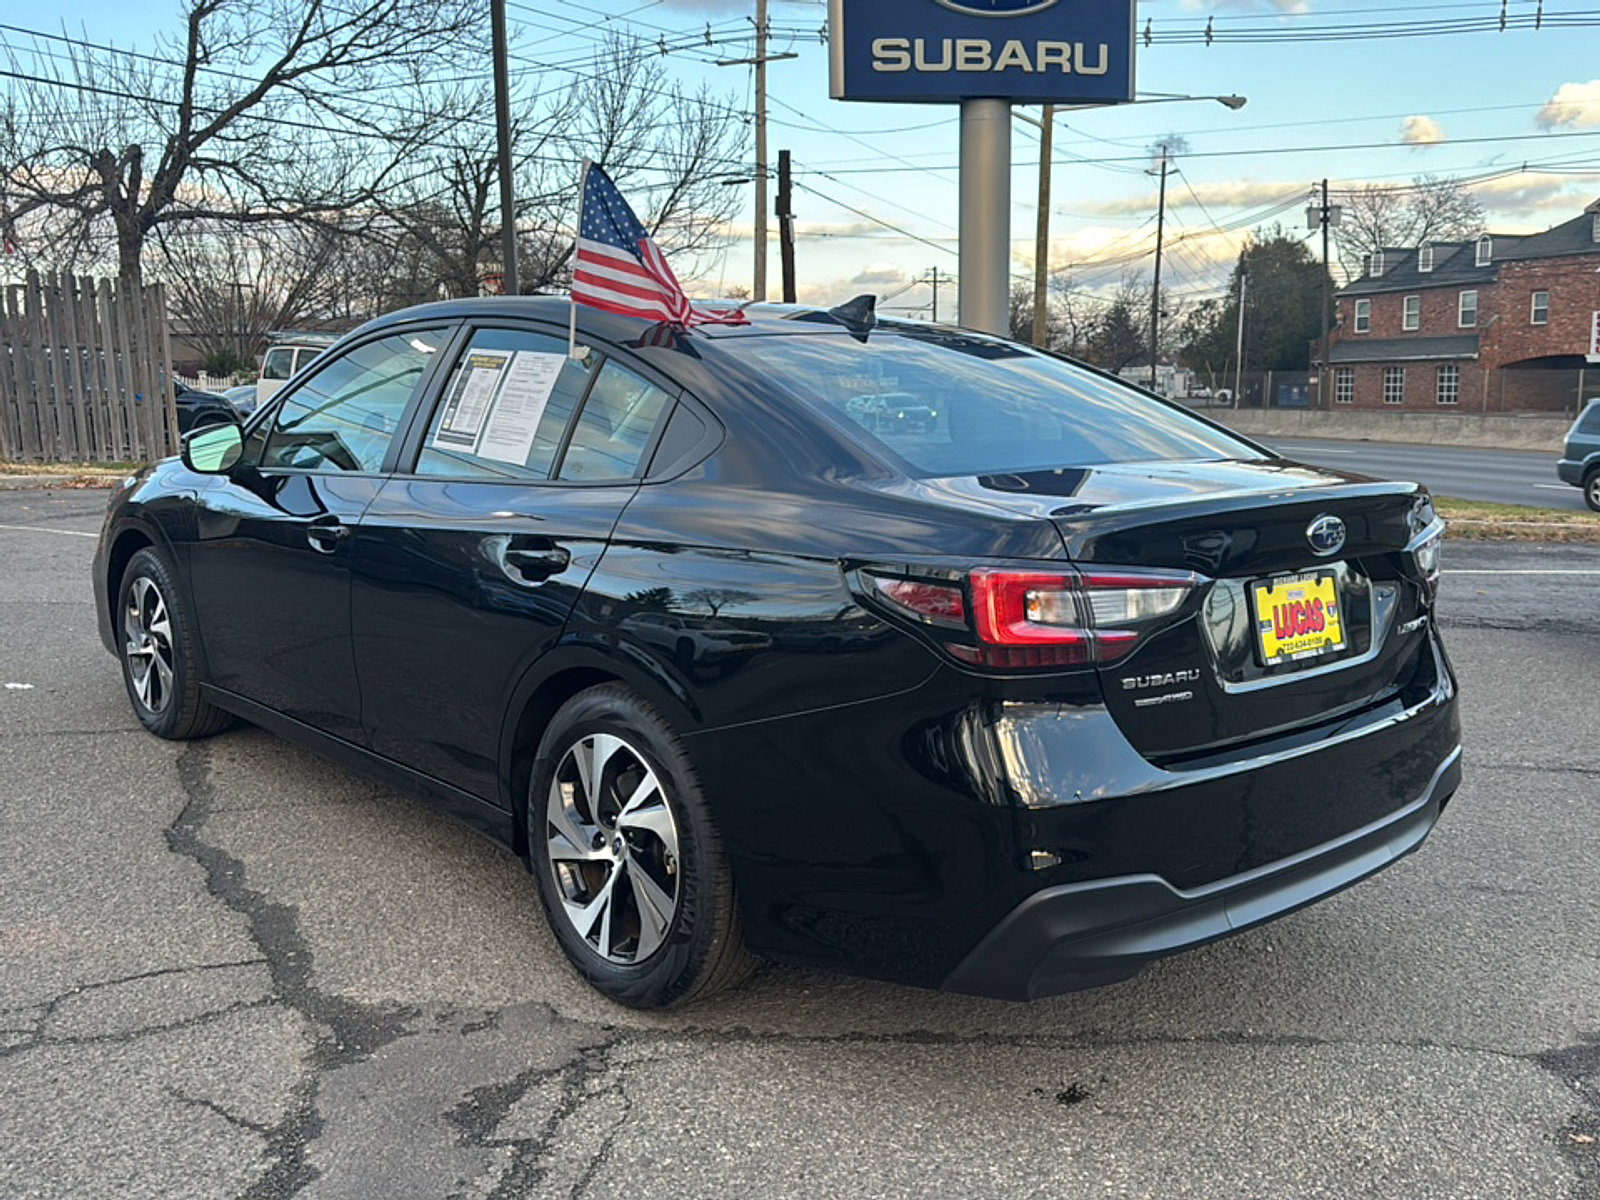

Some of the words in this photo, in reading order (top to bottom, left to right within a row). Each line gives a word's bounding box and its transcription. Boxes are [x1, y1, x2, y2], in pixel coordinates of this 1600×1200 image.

[871, 37, 1109, 75] SUBARU
[1273, 597, 1325, 639] LUCAS
[1121, 668, 1200, 690] SUBARU
